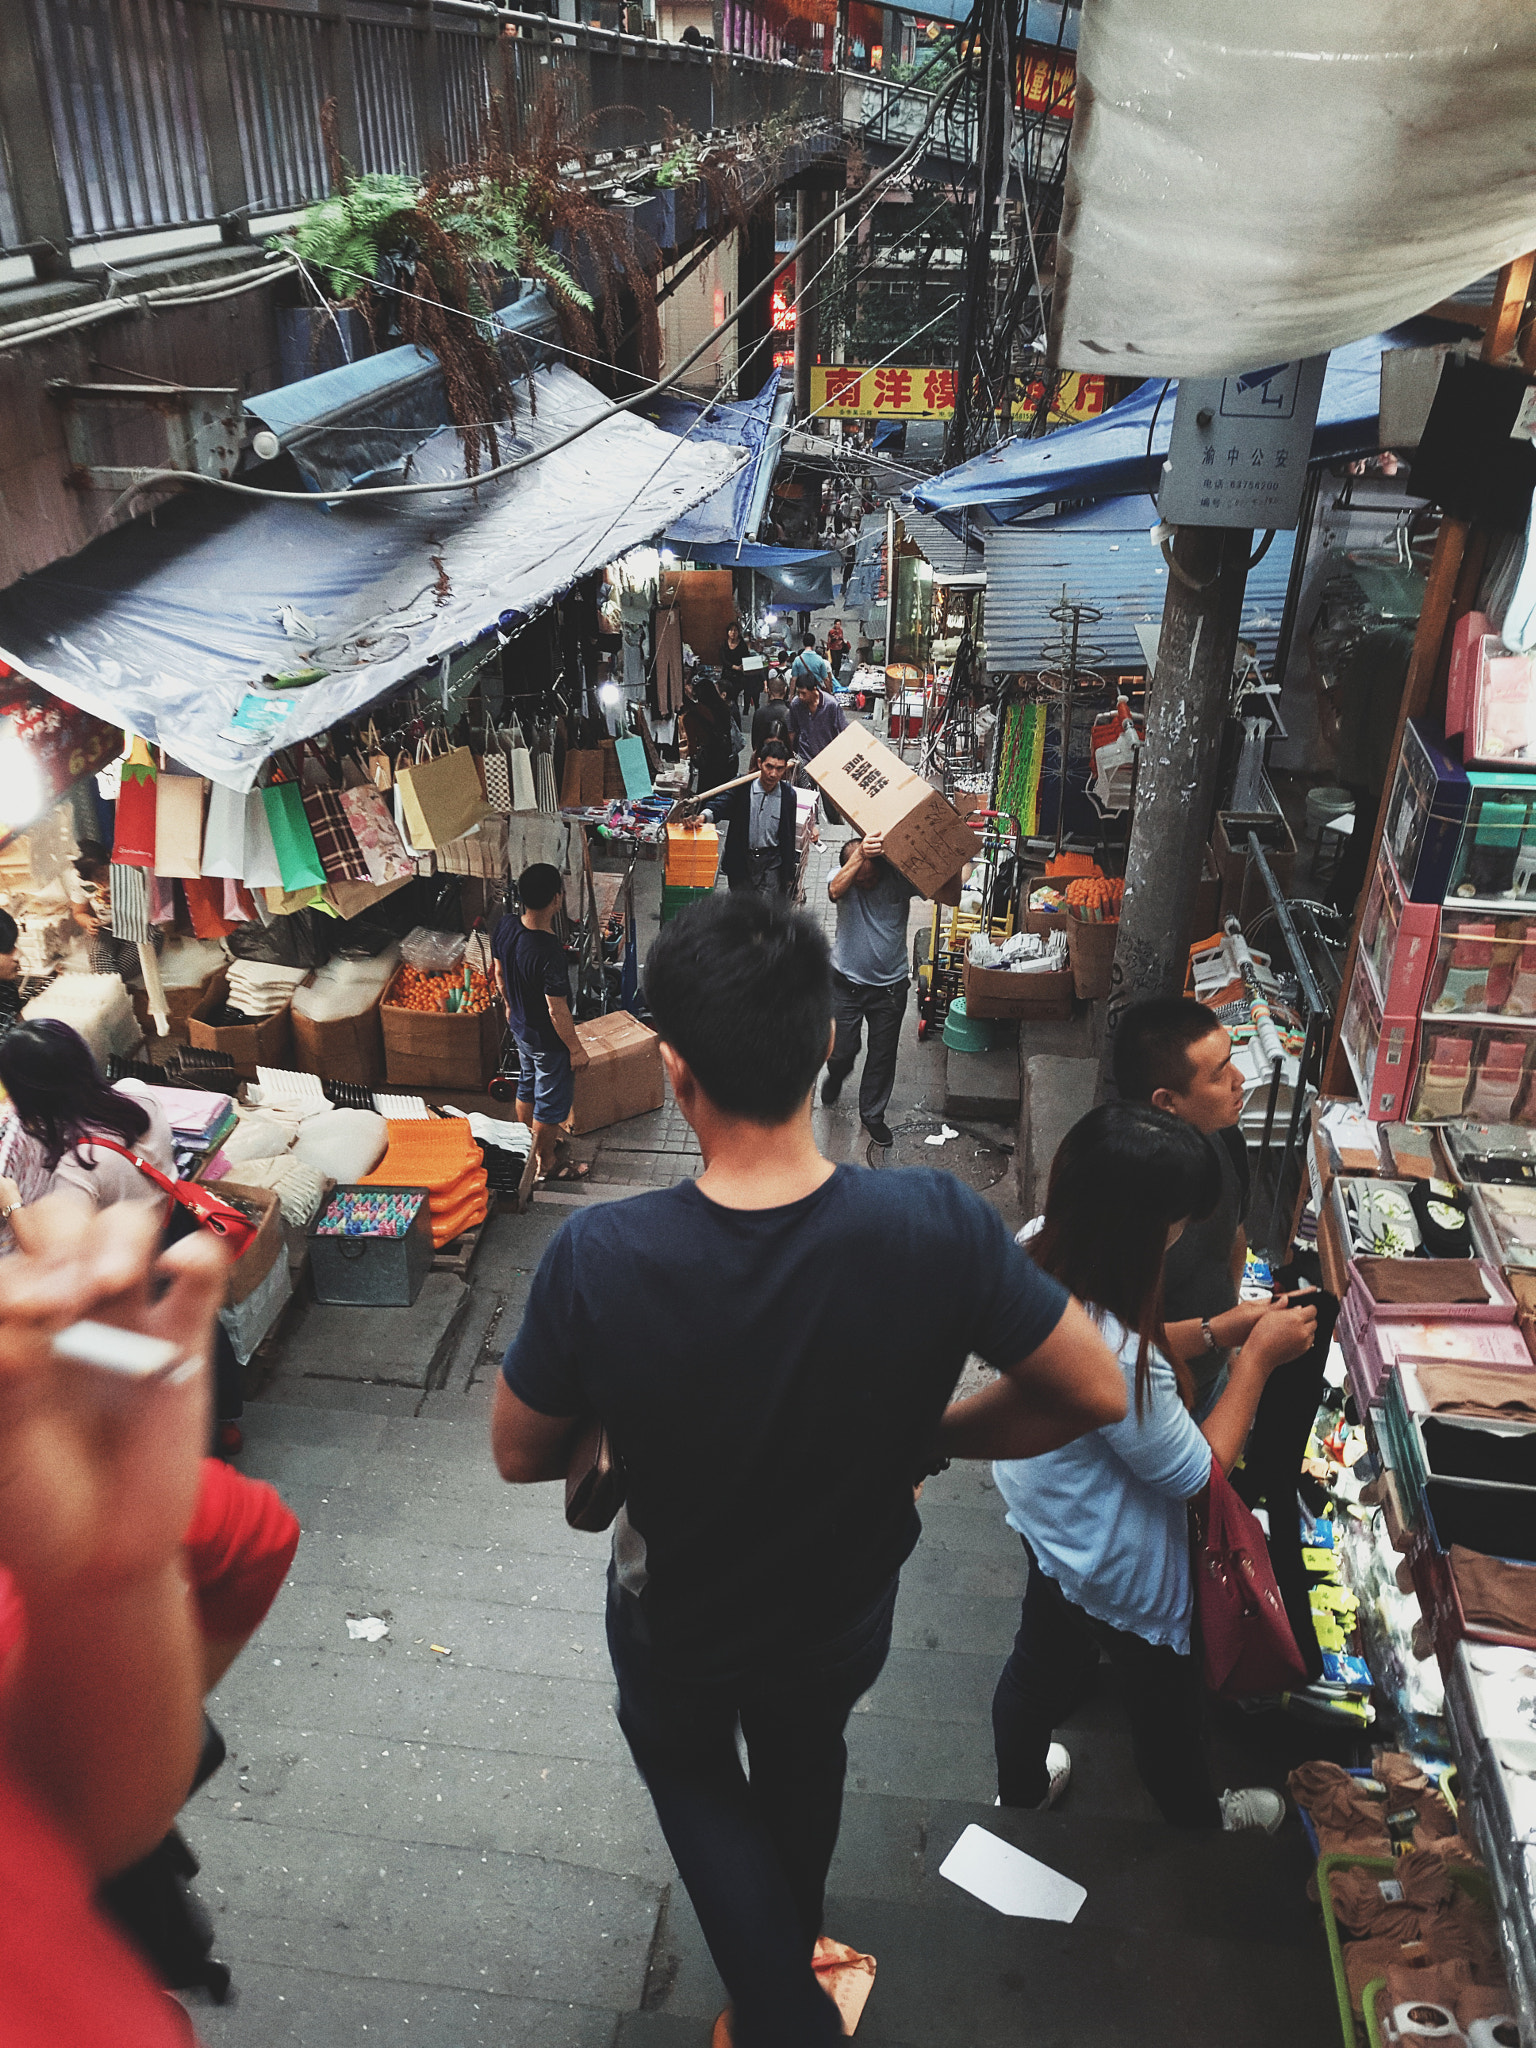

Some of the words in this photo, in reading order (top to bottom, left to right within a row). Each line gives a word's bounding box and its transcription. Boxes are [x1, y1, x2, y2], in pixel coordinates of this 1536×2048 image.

[825, 368, 1105, 413] 南洋模厅
[1202, 446, 1289, 467] 渝中公安
